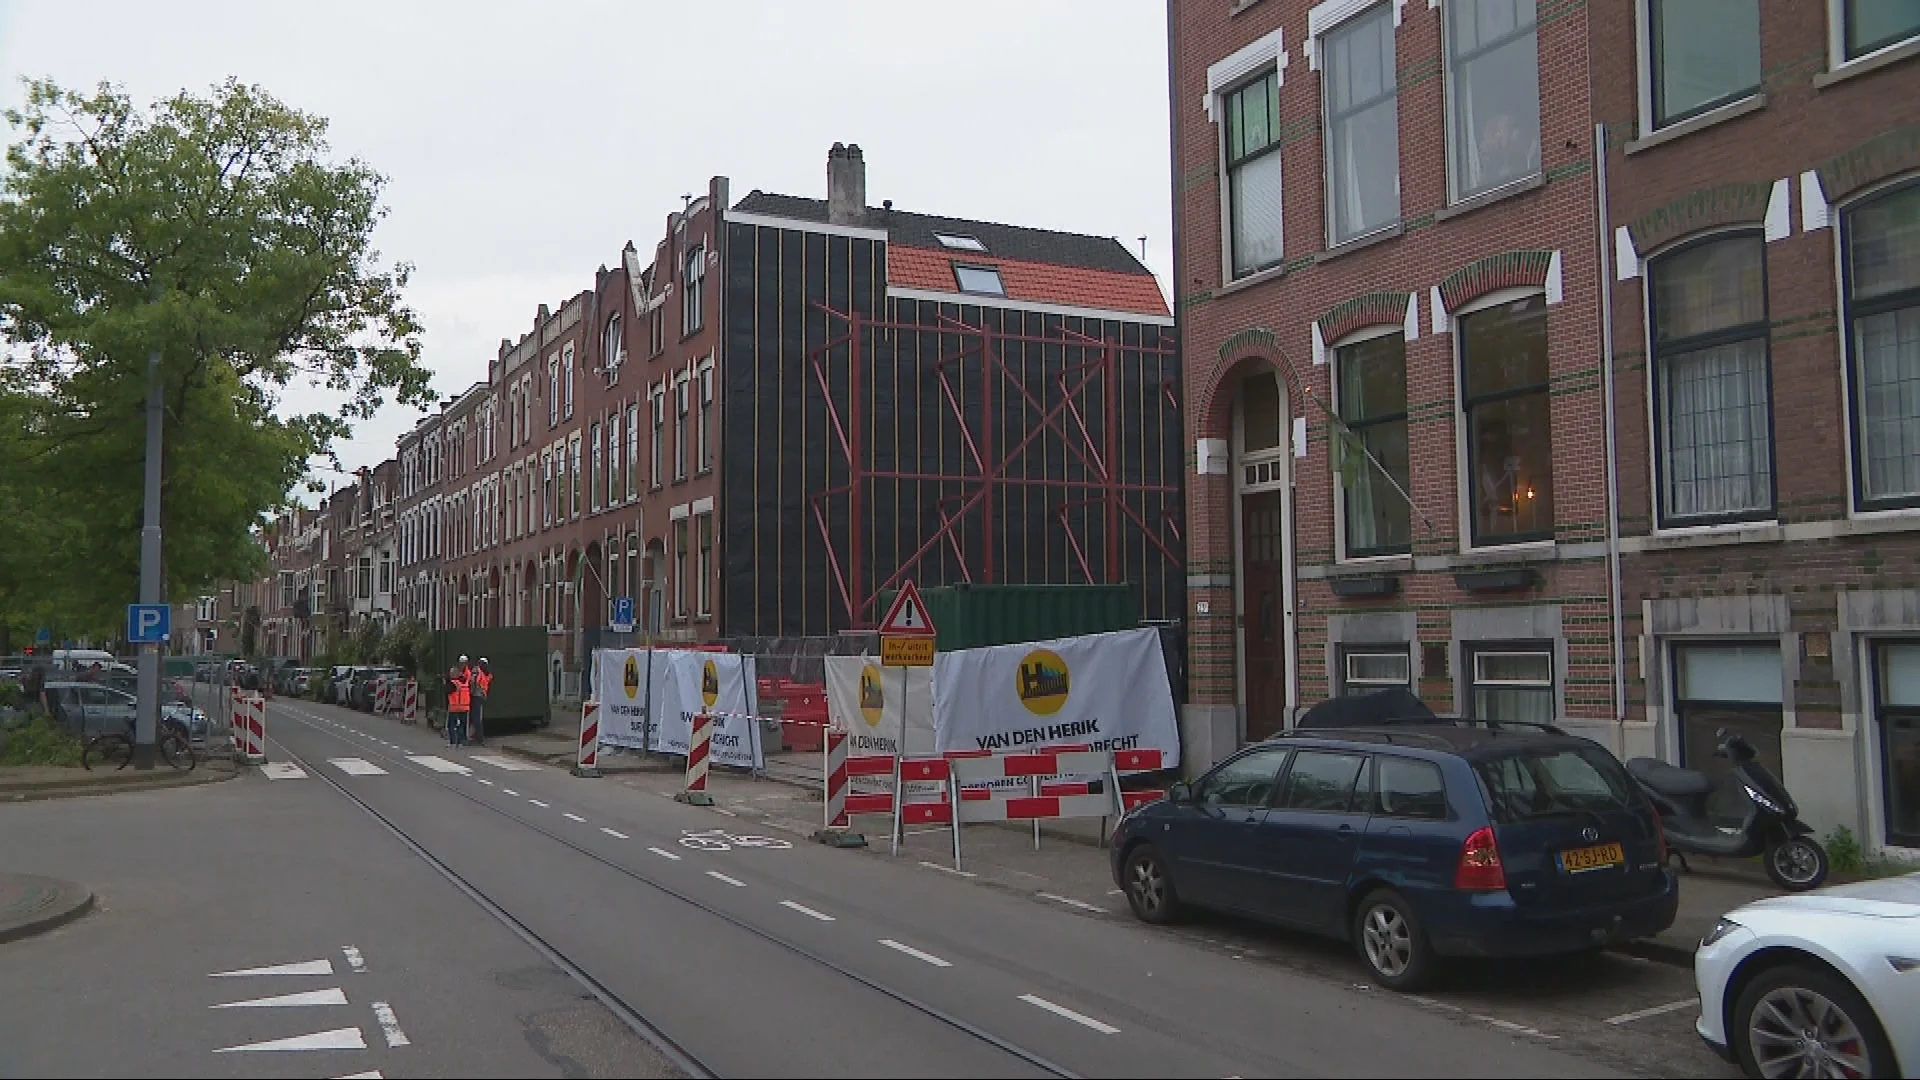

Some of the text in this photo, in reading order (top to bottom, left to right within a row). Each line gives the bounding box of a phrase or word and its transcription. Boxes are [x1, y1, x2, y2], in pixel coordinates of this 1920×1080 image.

[619, 599, 630, 613] P
[139, 609, 161, 637] P
[975, 718, 1100, 749] VAN DEN HERIK
